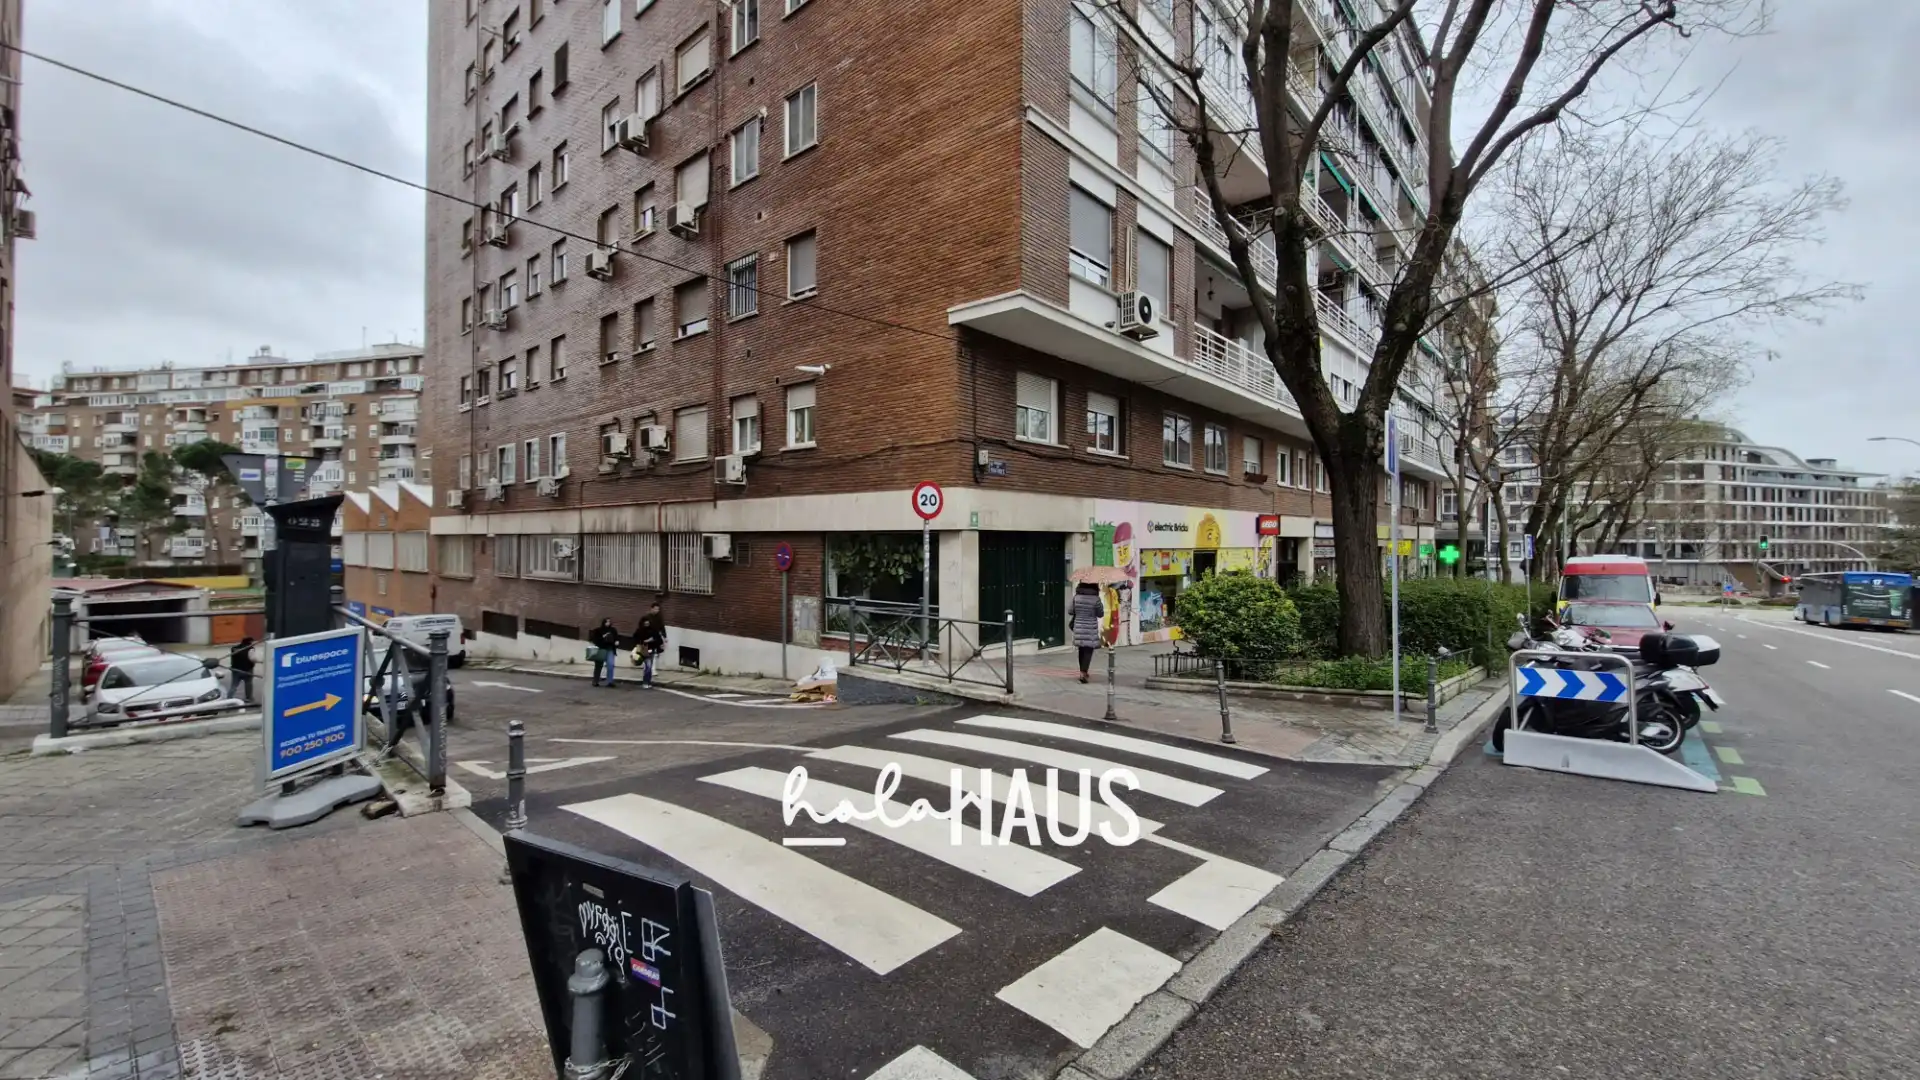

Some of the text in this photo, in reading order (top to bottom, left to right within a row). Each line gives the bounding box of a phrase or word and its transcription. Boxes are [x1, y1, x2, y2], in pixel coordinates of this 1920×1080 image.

[920, 494, 937, 507] 20
[1154, 520, 1174, 532] electric
[1261, 519, 1278, 528] LEGO
[295, 648, 349, 665] bluespace
[307, 732, 316, 740] TU
[280, 732, 346, 759] 900 250 900
